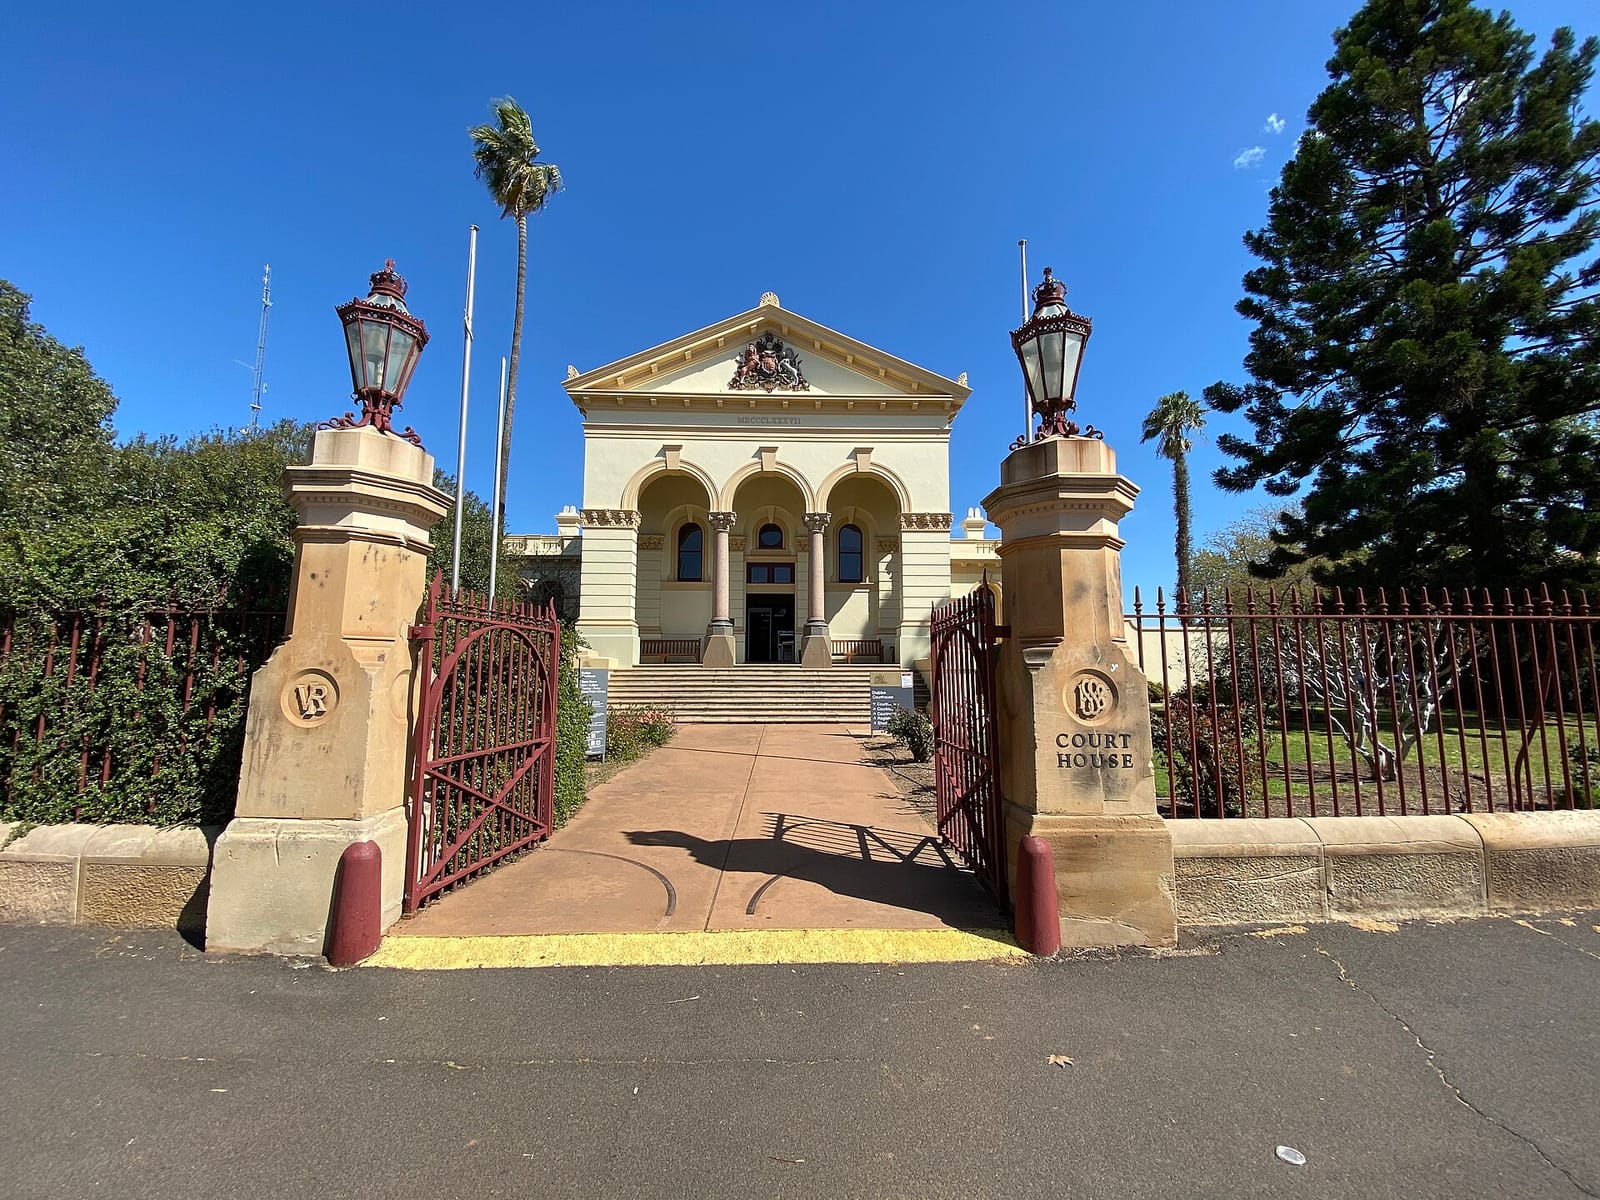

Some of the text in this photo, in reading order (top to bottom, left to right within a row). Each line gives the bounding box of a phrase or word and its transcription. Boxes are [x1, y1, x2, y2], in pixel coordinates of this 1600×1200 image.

[294, 684, 328, 719] VR
[1055, 733, 1131, 748] COURT
[1056, 753, 1134, 768] HOUSE
